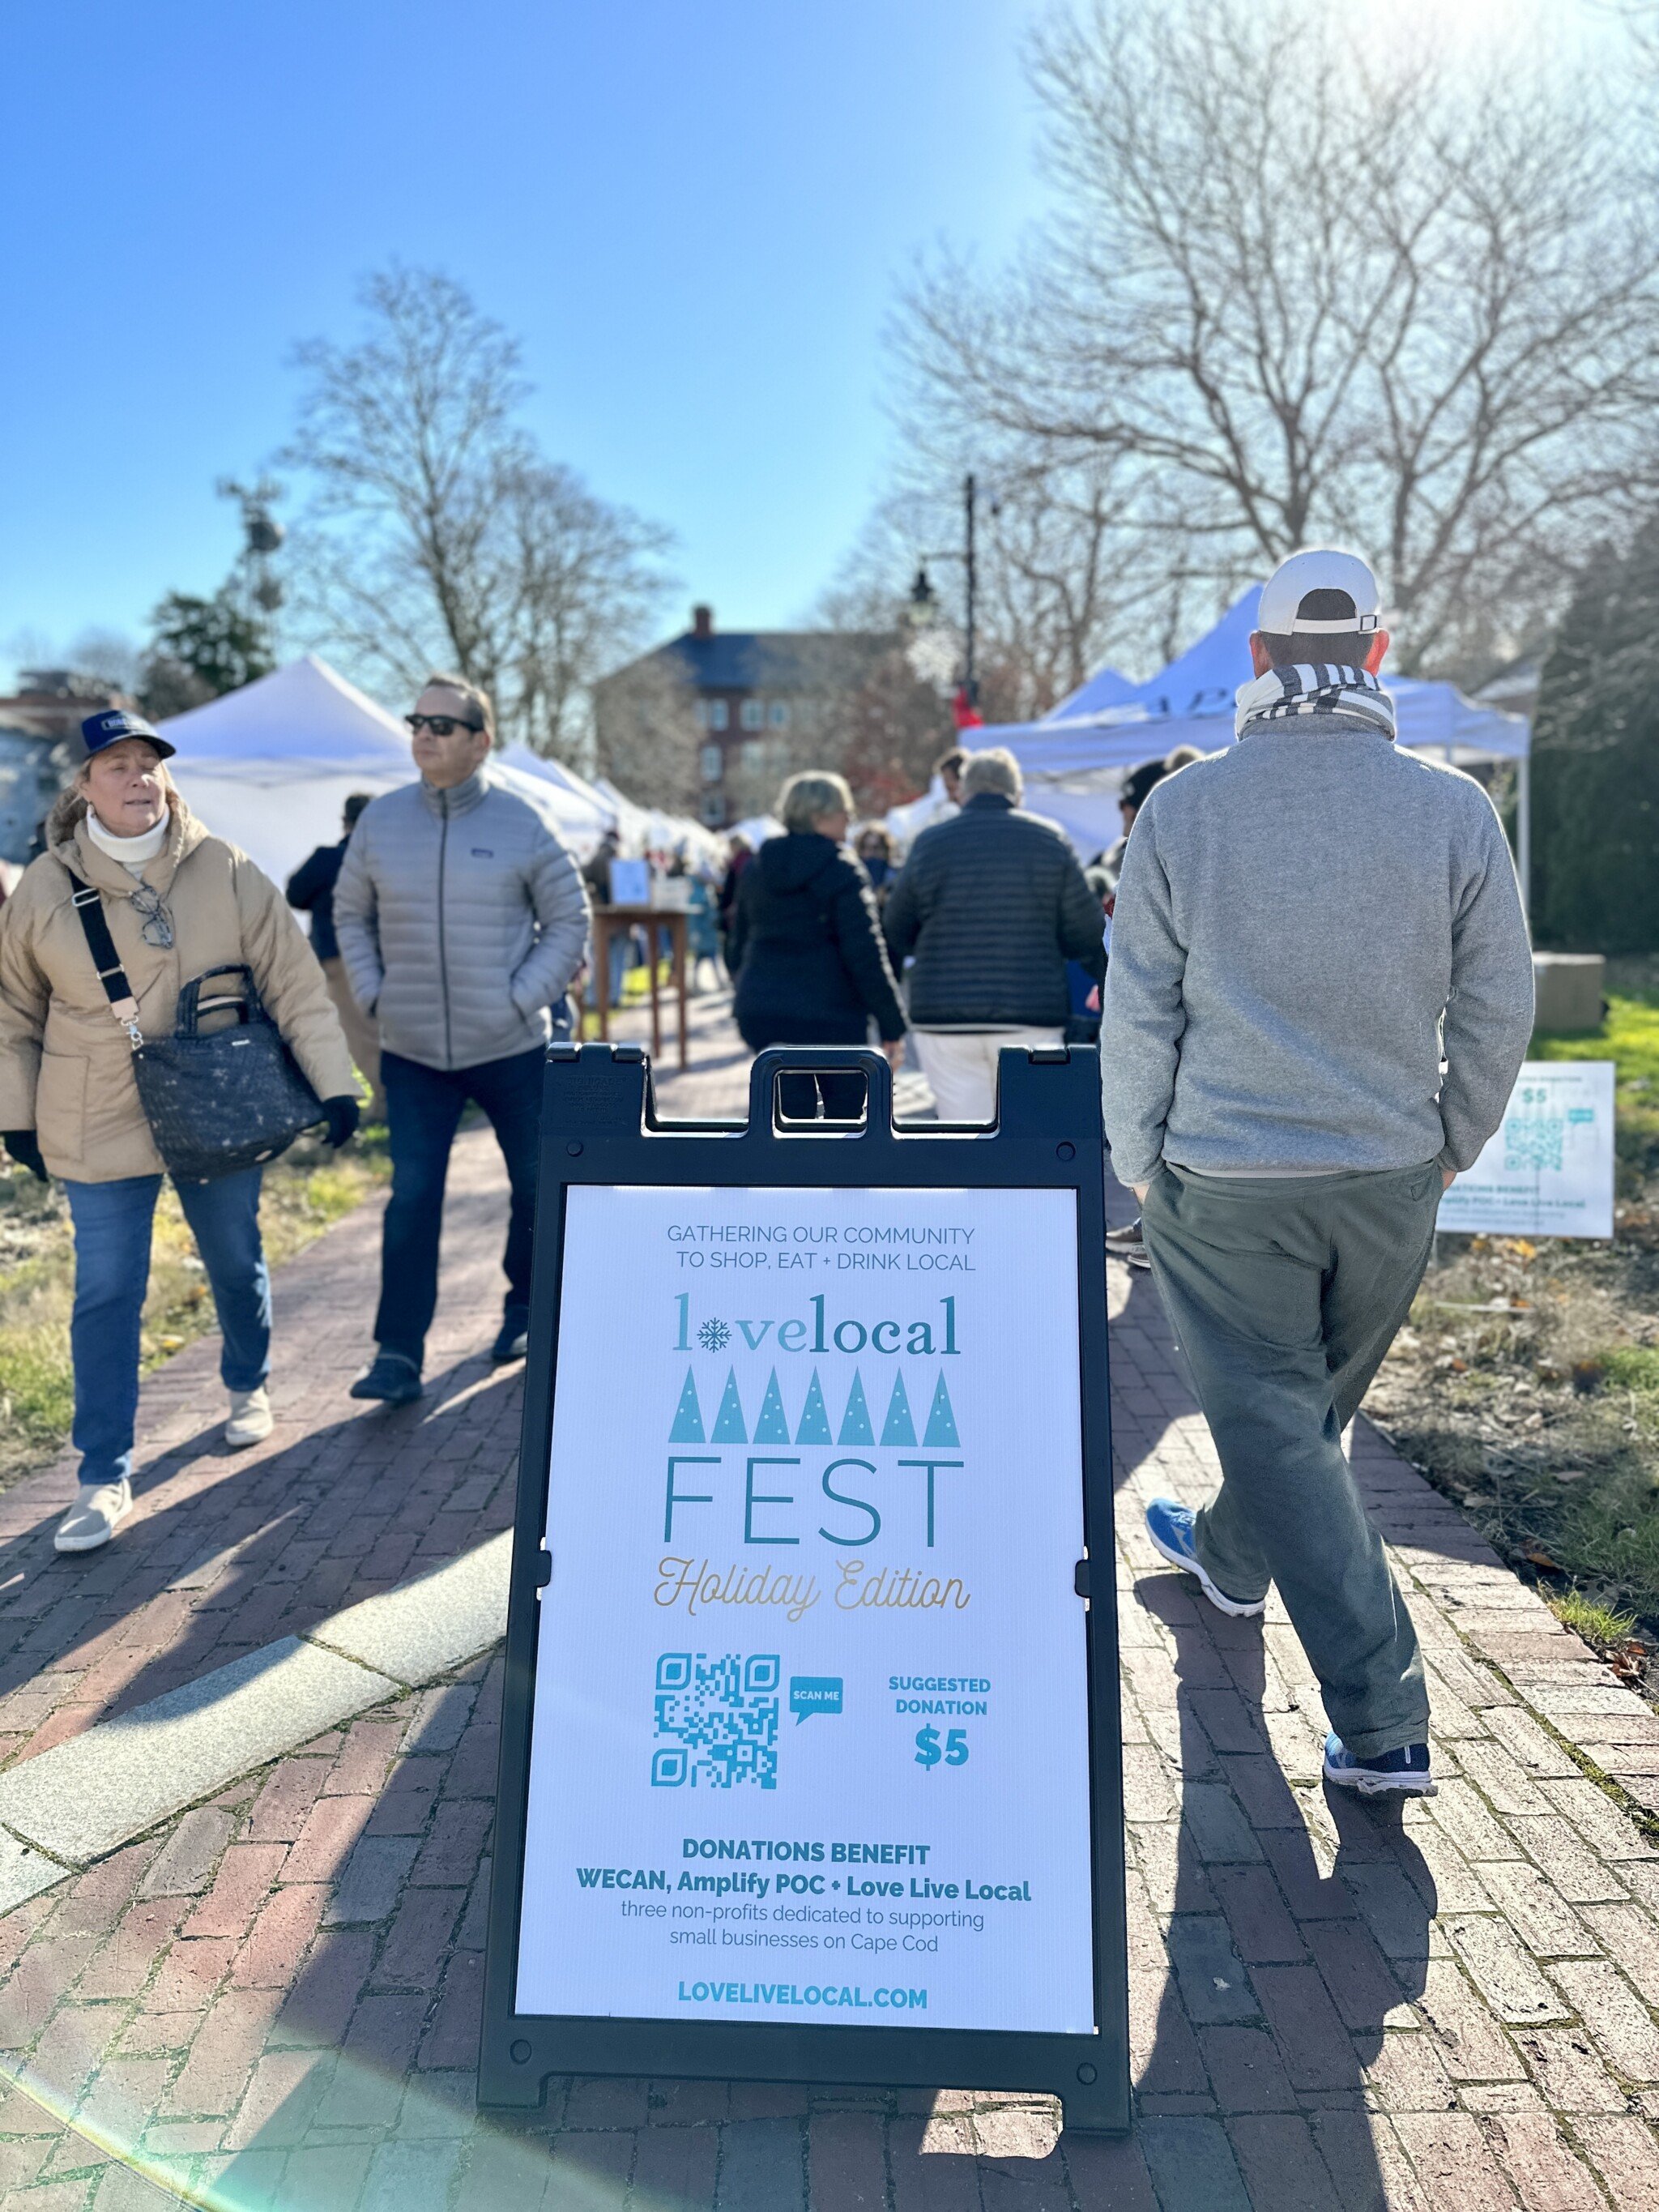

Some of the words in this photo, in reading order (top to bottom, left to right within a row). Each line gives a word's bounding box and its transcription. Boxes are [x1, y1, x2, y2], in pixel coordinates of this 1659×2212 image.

[667, 1224, 787, 1243] GATHERING
[792, 1226, 838, 1244] OUR
[843, 1227, 975, 1245] COMMUNITY
[676, 1251, 705, 1268] TO
[710, 1251, 771, 1270] SHOP,
[778, 1252, 818, 1269] EAT
[822, 1257, 831, 1266] +
[837, 1252, 901, 1270] DRINK
[906, 1253, 976, 1271] LOCAL
[663, 1456, 965, 1548] FEST
[653, 1557, 821, 1622] Holiday
[834, 1559, 971, 1610] Edition
[793, 1690, 822, 1701] SCAN
[824, 1691, 840, 1701] ME
[888, 1676, 992, 1693] SUGGESTED
[895, 1698, 987, 1716] DONATION
[914, 1722, 970, 1772] $5
[682, 1838, 825, 1863] DONATIONS
[830, 1842, 932, 1865] BENEFIT
[575, 1868, 672, 1894] WECAN,
[676, 1870, 771, 1899] Amplify
[775, 1873, 826, 1895] POC
[831, 1880, 841, 1891] +
[847, 1875, 905, 1898] Love
[910, 1877, 960, 1899] Live
[965, 1879, 1032, 1902] Local
[621, 1899, 667, 1918] three
[672, 1902, 768, 1924] non-profits
[772, 1904, 861, 1924] dedicated
[866, 1907, 885, 1924] to
[889, 1910, 984, 1932] supporting
[669, 1928, 718, 1945] small
[722, 1928, 819, 1949] businesses
[823, 1936, 846, 1949] on
[851, 1932, 898, 1955] Cape
[902, 1934, 939, 1953] Cod
[678, 1980, 928, 2009] LOVELIVELOCAL.COM
